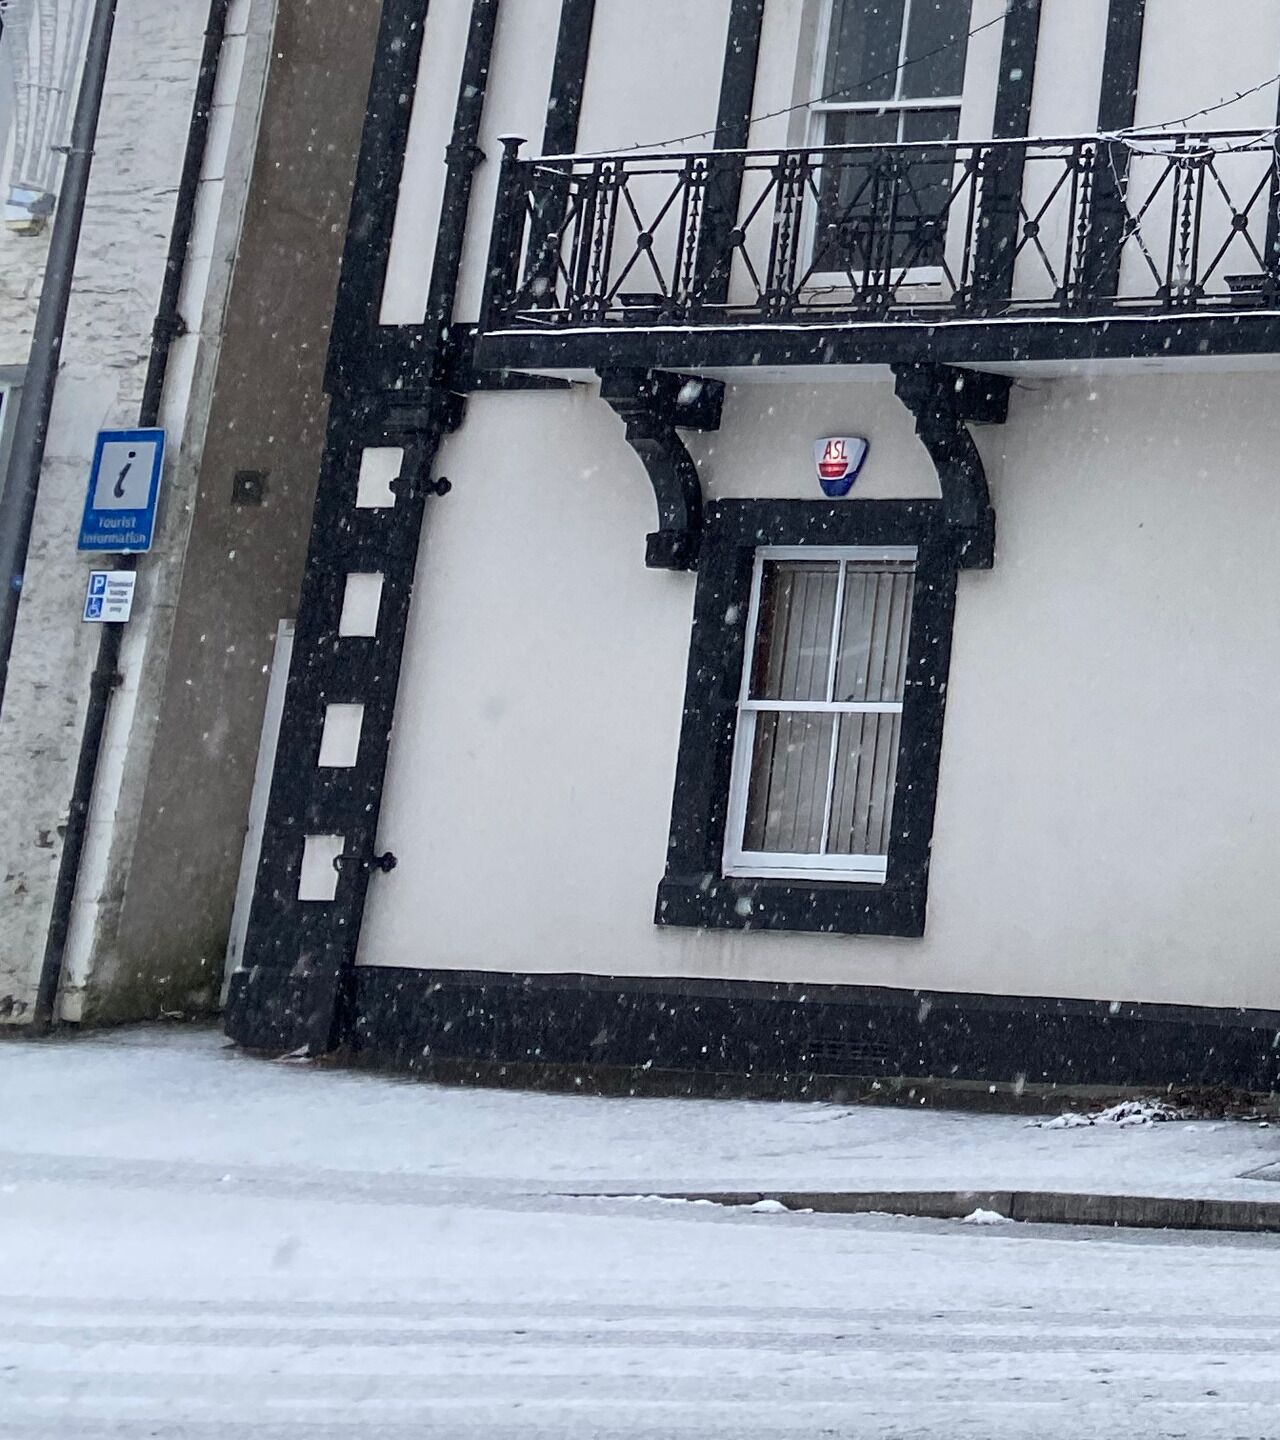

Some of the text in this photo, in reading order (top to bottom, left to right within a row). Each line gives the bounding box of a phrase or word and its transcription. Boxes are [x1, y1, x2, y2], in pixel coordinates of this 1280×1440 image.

[823, 440, 848, 460] ASL
[98, 516, 136, 529] Tourist
[93, 576, 105, 594] P
